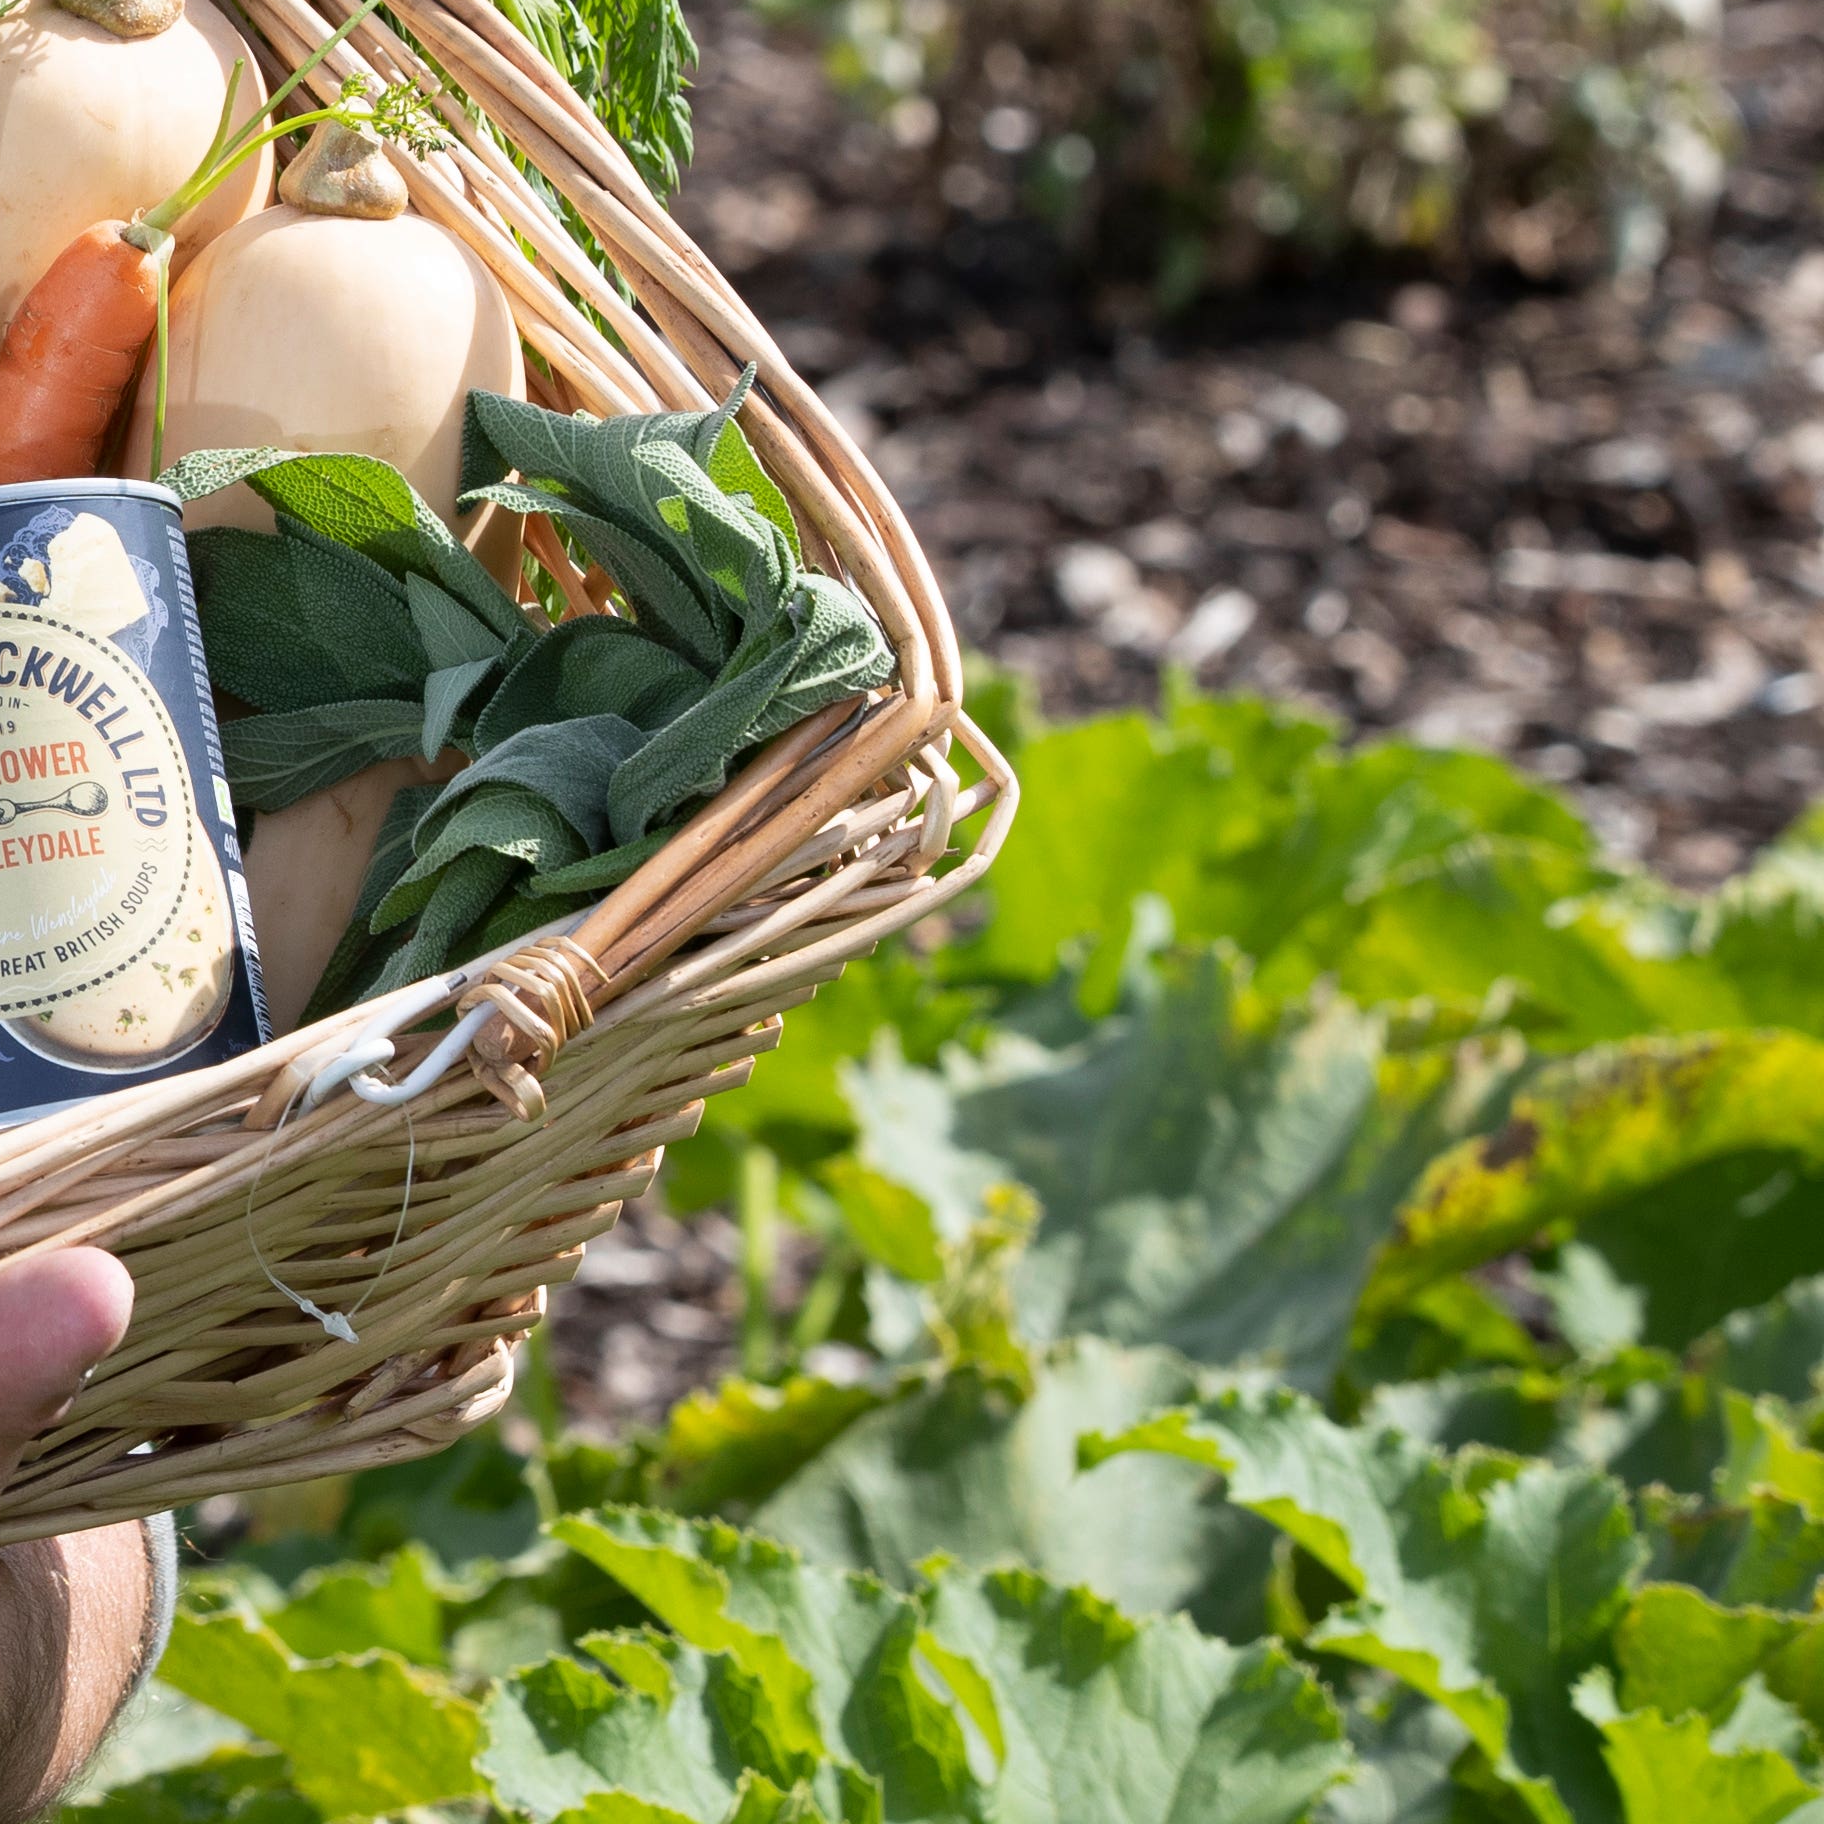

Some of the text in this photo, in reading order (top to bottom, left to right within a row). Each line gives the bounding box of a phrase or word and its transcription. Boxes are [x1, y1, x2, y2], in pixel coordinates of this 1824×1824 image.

[121, 767, 170, 829] LTD
[54, 912, 126, 963] BRITISH
[120, 861, 158, 915] SOUPS
